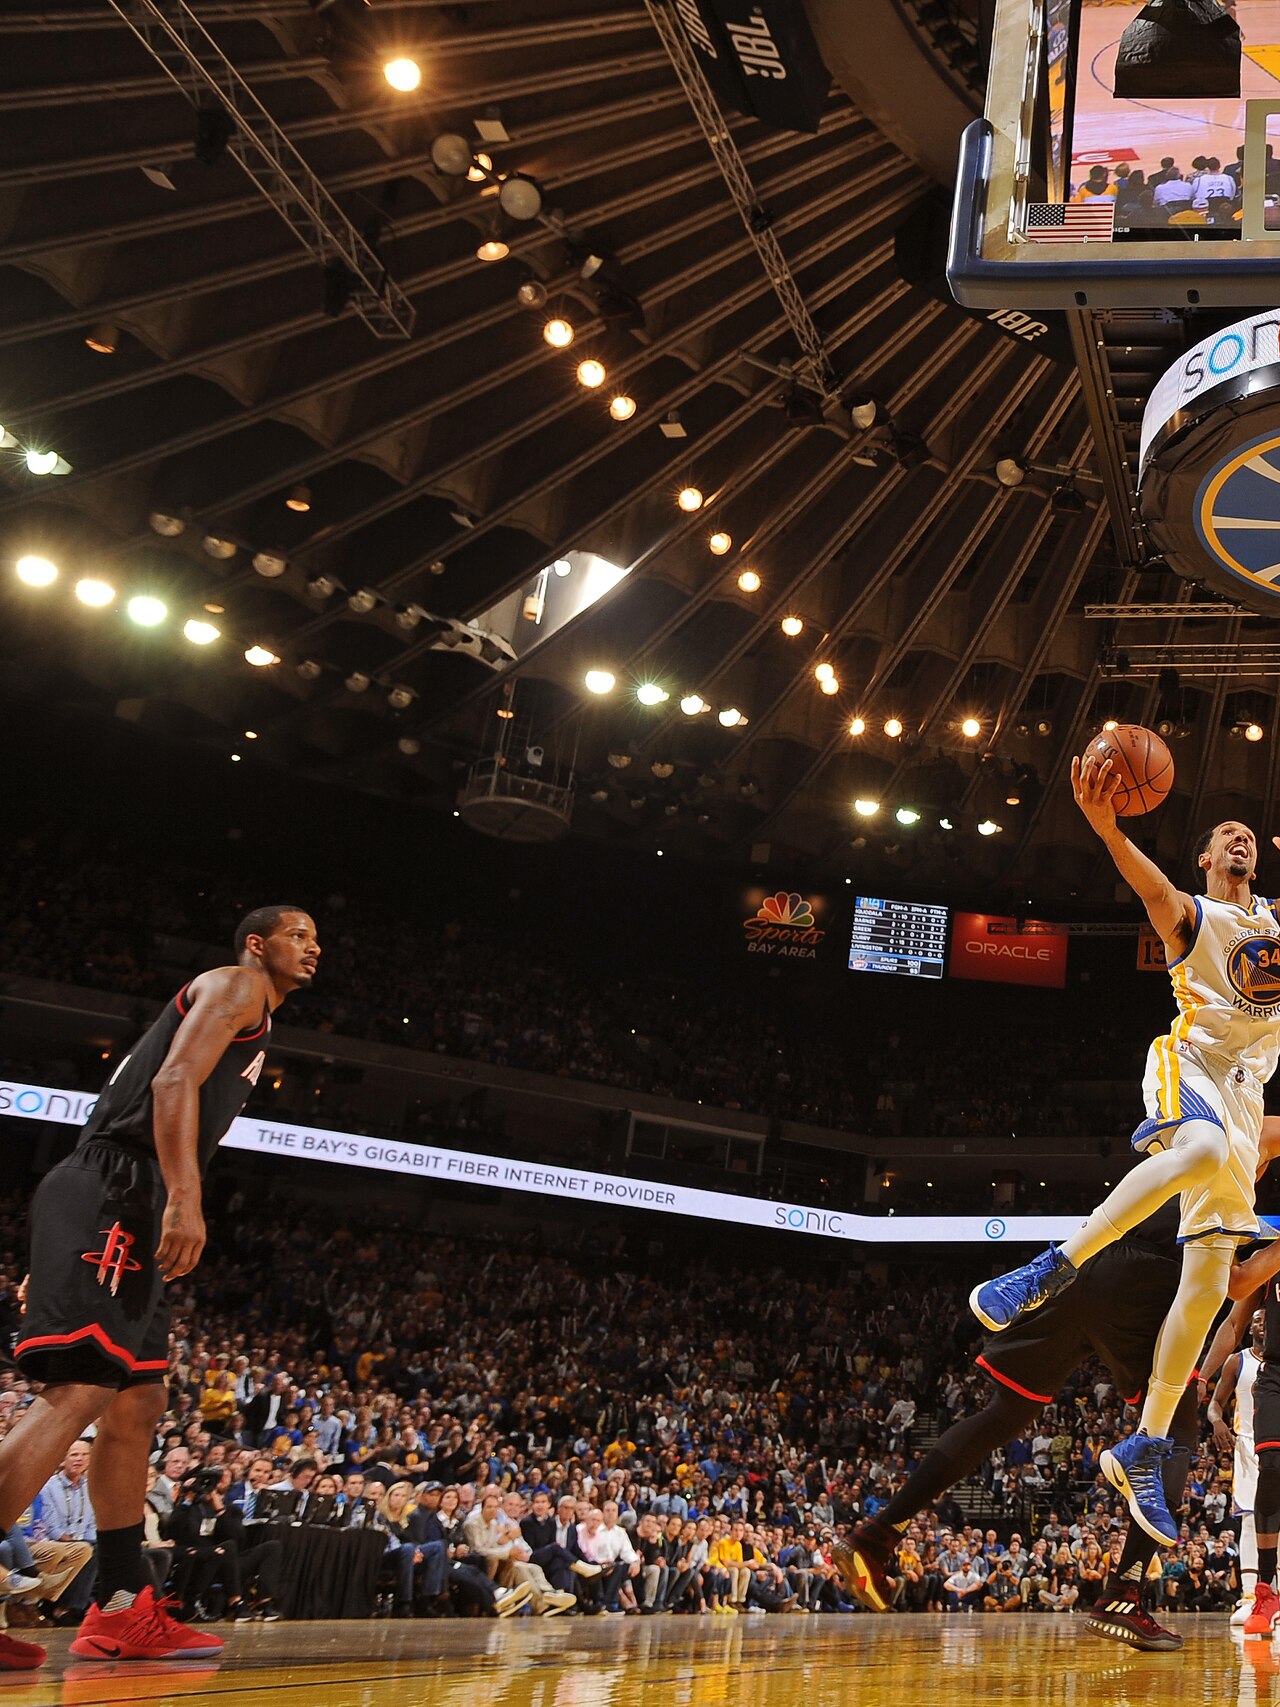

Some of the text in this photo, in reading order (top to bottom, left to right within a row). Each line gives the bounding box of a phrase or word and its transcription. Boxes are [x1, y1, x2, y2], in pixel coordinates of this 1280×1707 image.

[725, 14, 787, 80] JBL
[1207, 188, 1225, 198] 23
[743, 918, 826, 945] Sports
[1223, 928, 1261, 954] GOLDEN
[747, 942, 817, 958] BAY AREA
[965, 941, 1051, 961] ORACLE
[257, 1128, 676, 1205] THE BAY'S GIGABIT FIBER INTERNET PROVIDER
